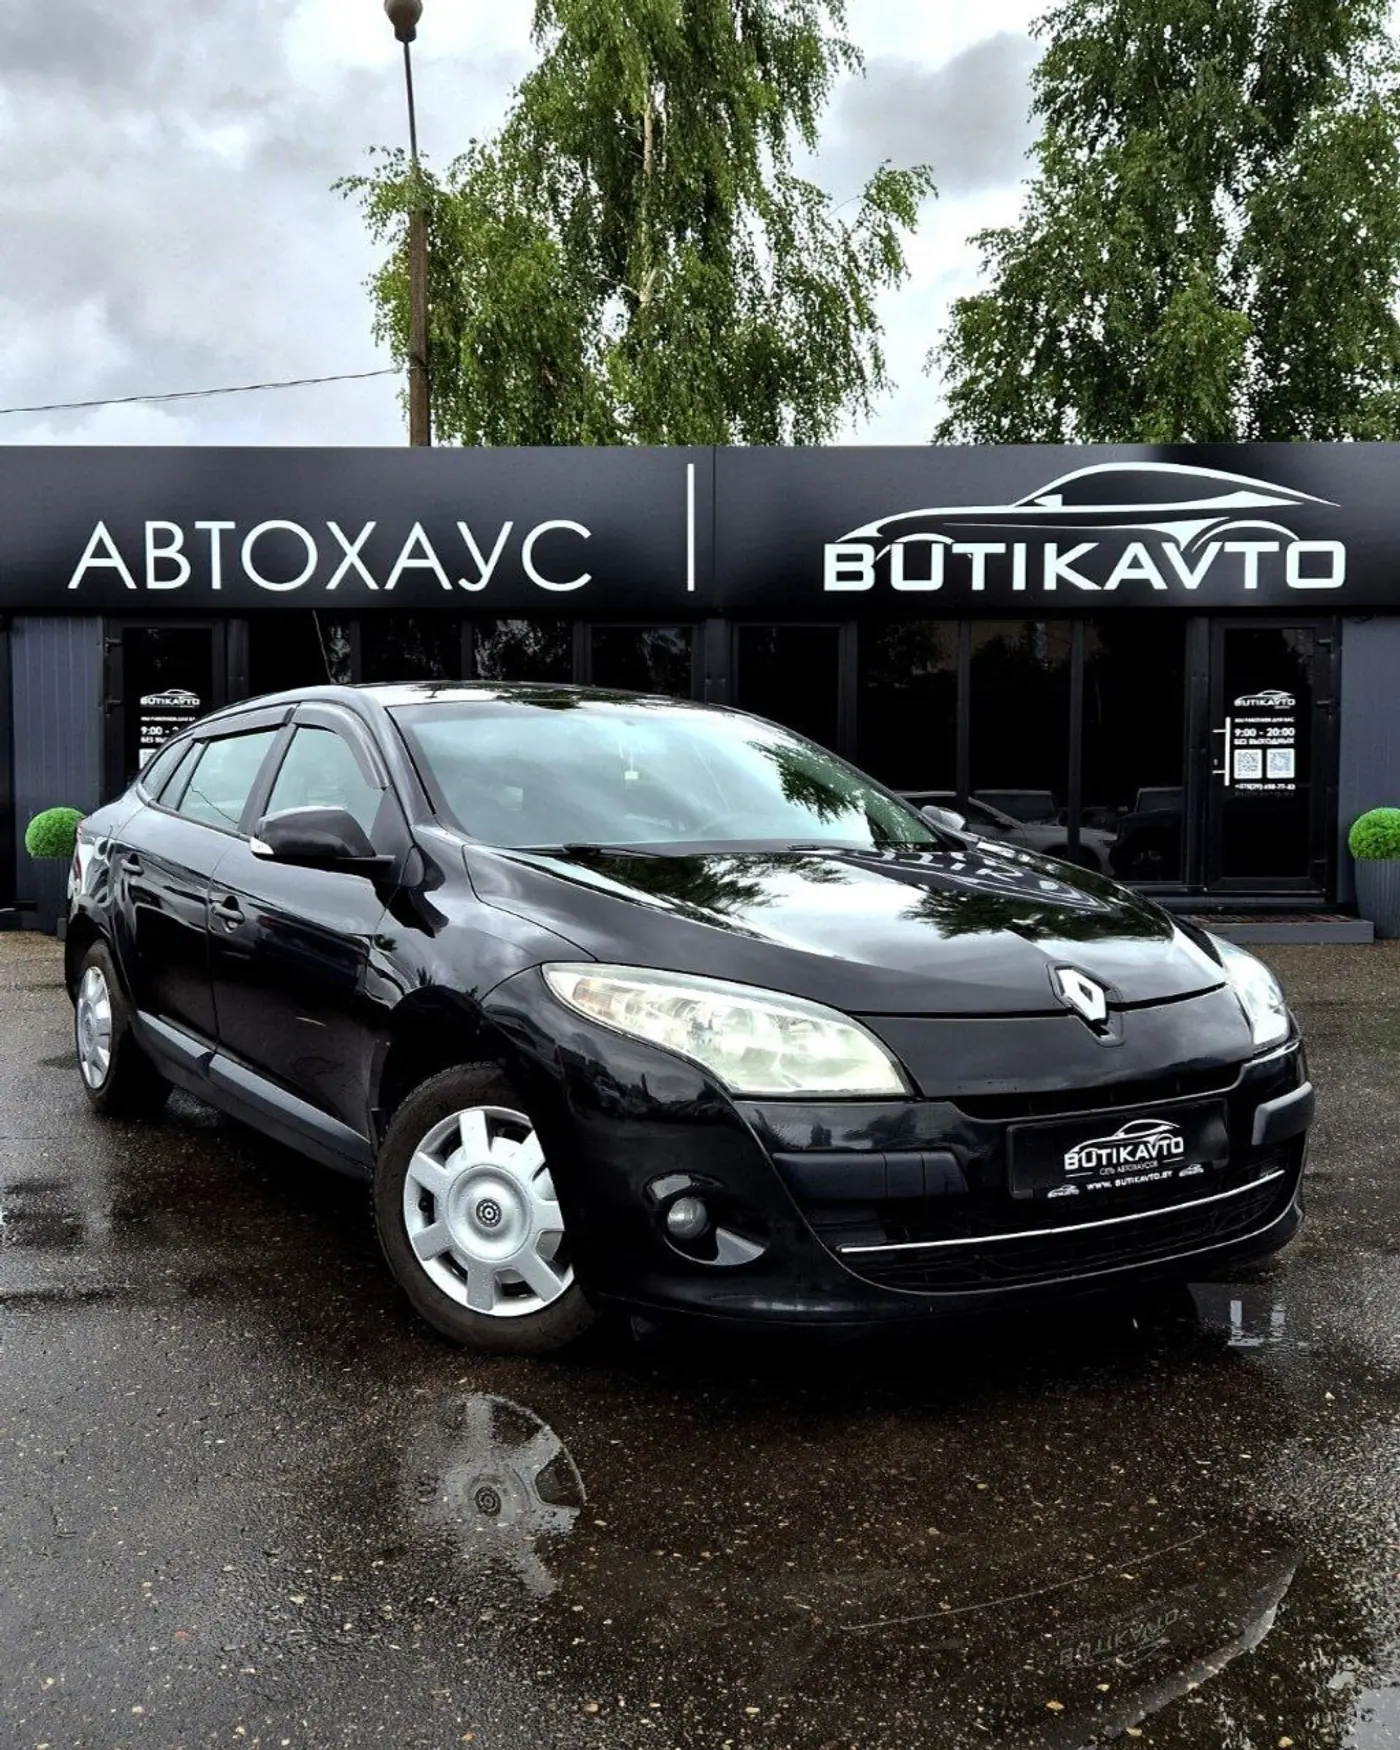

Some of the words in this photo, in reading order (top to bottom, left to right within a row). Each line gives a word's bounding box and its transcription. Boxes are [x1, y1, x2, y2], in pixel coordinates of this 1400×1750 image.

[68, 519, 592, 592] АВТОХАУС
[823, 540, 1347, 592] BUTIKAVTO
[140, 726, 163, 735] 9:00
[1234, 728, 1257, 737] 9:00
[1266, 728, 1295, 736] 20:00
[1063, 1137, 1184, 1171] BUTIKAVTO
